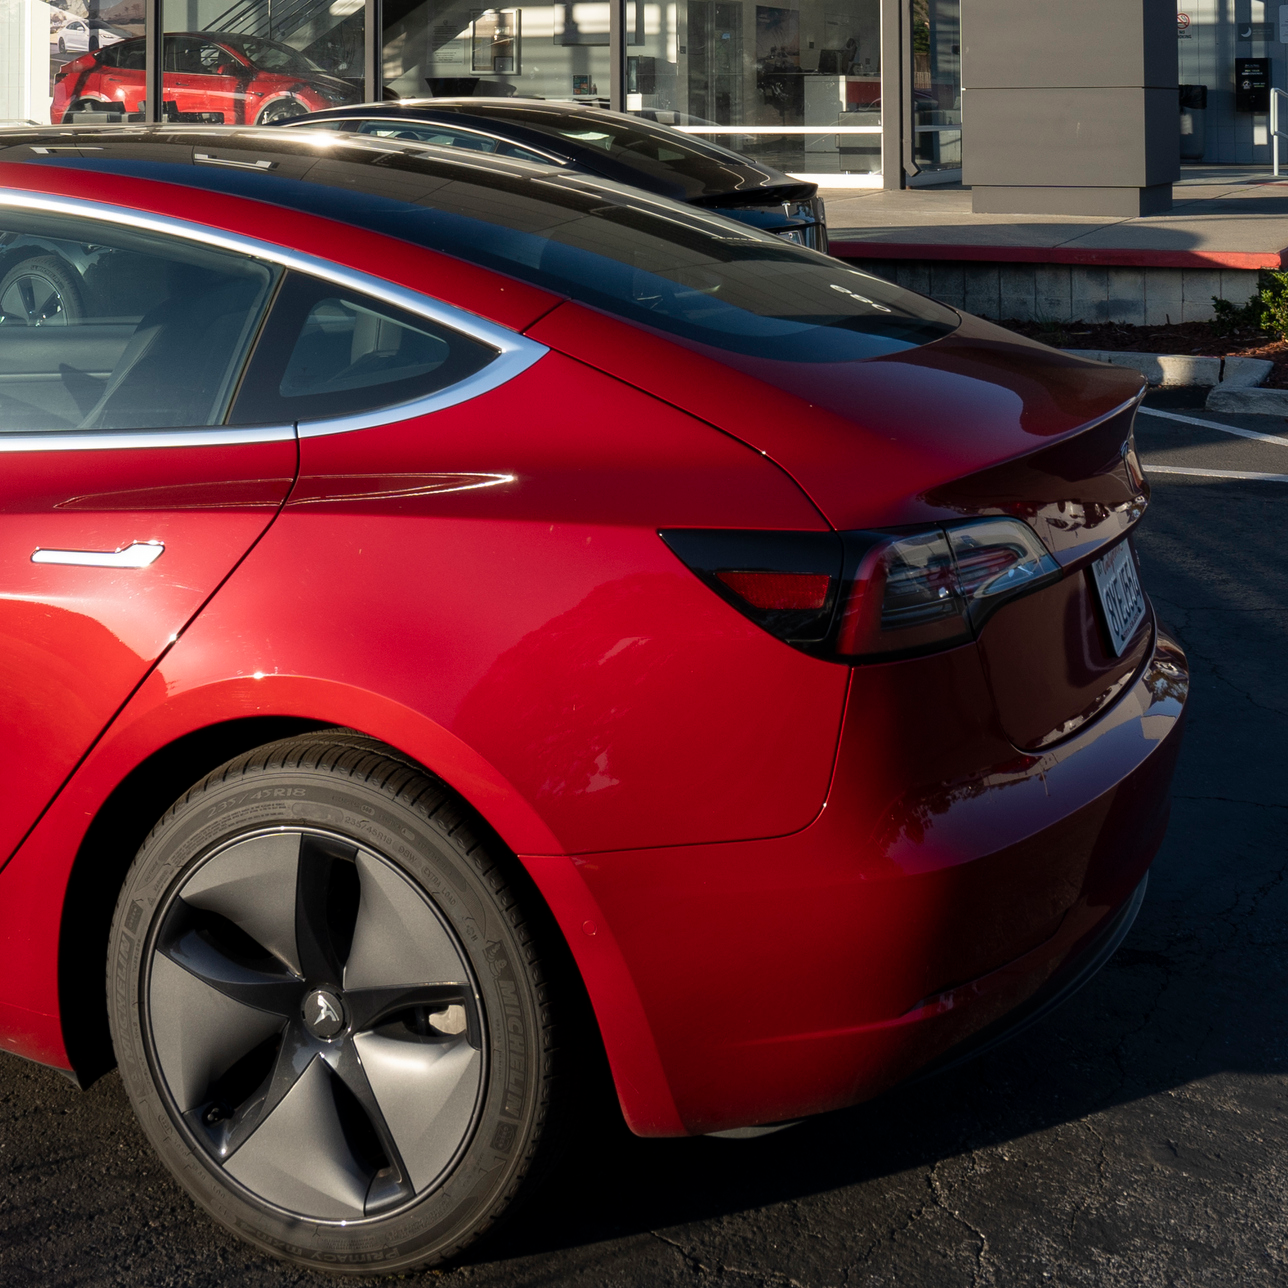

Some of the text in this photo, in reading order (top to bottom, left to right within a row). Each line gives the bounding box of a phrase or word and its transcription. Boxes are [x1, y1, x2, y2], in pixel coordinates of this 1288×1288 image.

[207, 787, 306, 820] 235/45R18
[345, 815, 393, 846] 235/45R18
[423, 866, 442, 888] EXTRA
[441, 886, 457, 906] LOAD
[115, 931, 134, 1063] MICHELIN
[498, 979, 527, 1119] MICHELIN
